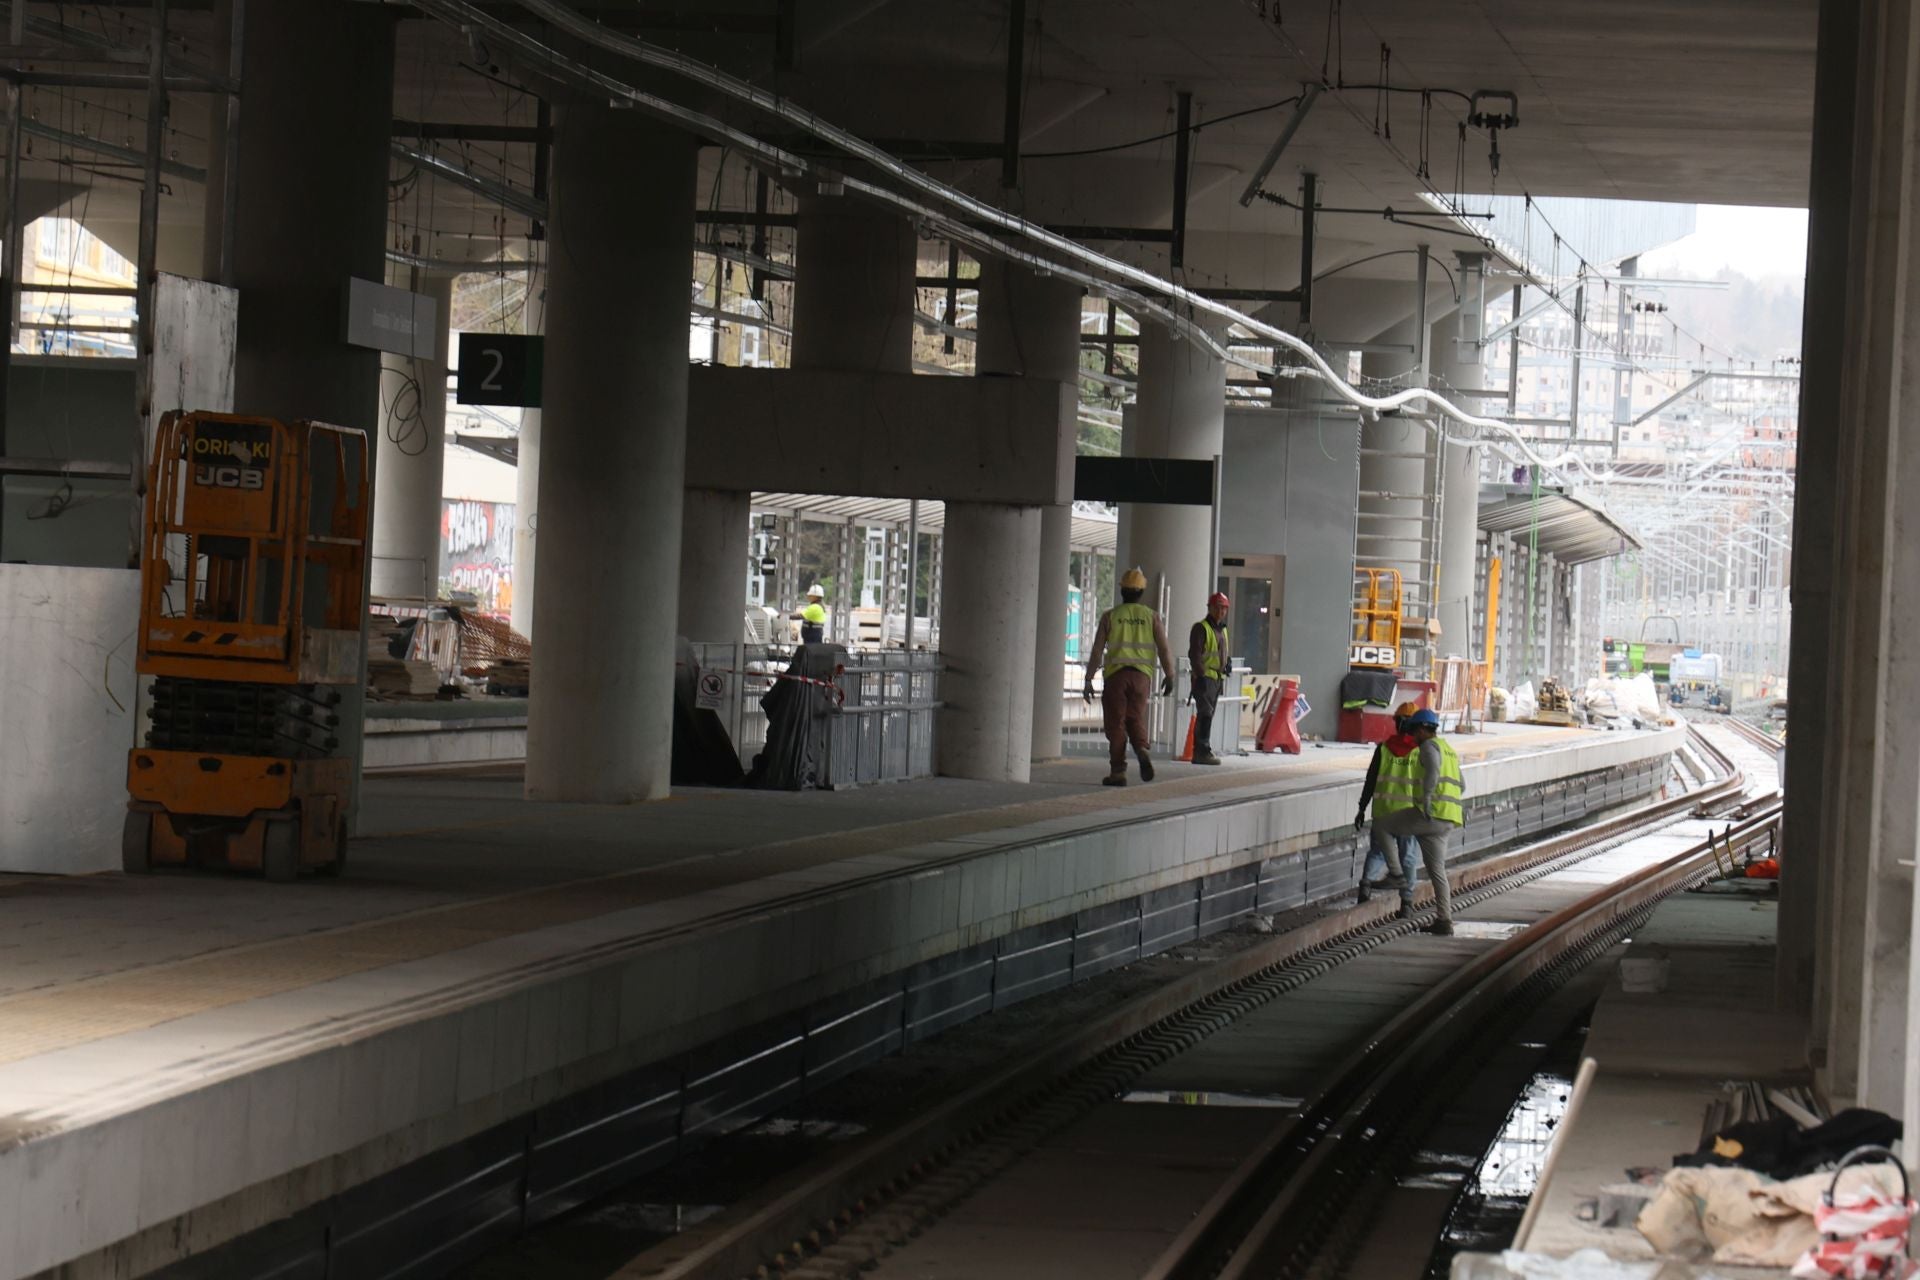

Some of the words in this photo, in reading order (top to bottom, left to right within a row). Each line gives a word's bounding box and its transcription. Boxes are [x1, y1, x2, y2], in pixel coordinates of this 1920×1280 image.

[480, 348, 504, 391] 2
[194, 437, 271, 459] ORIKI
[196, 465, 263, 490] JCB
[1349, 646, 1396, 665] JCB
